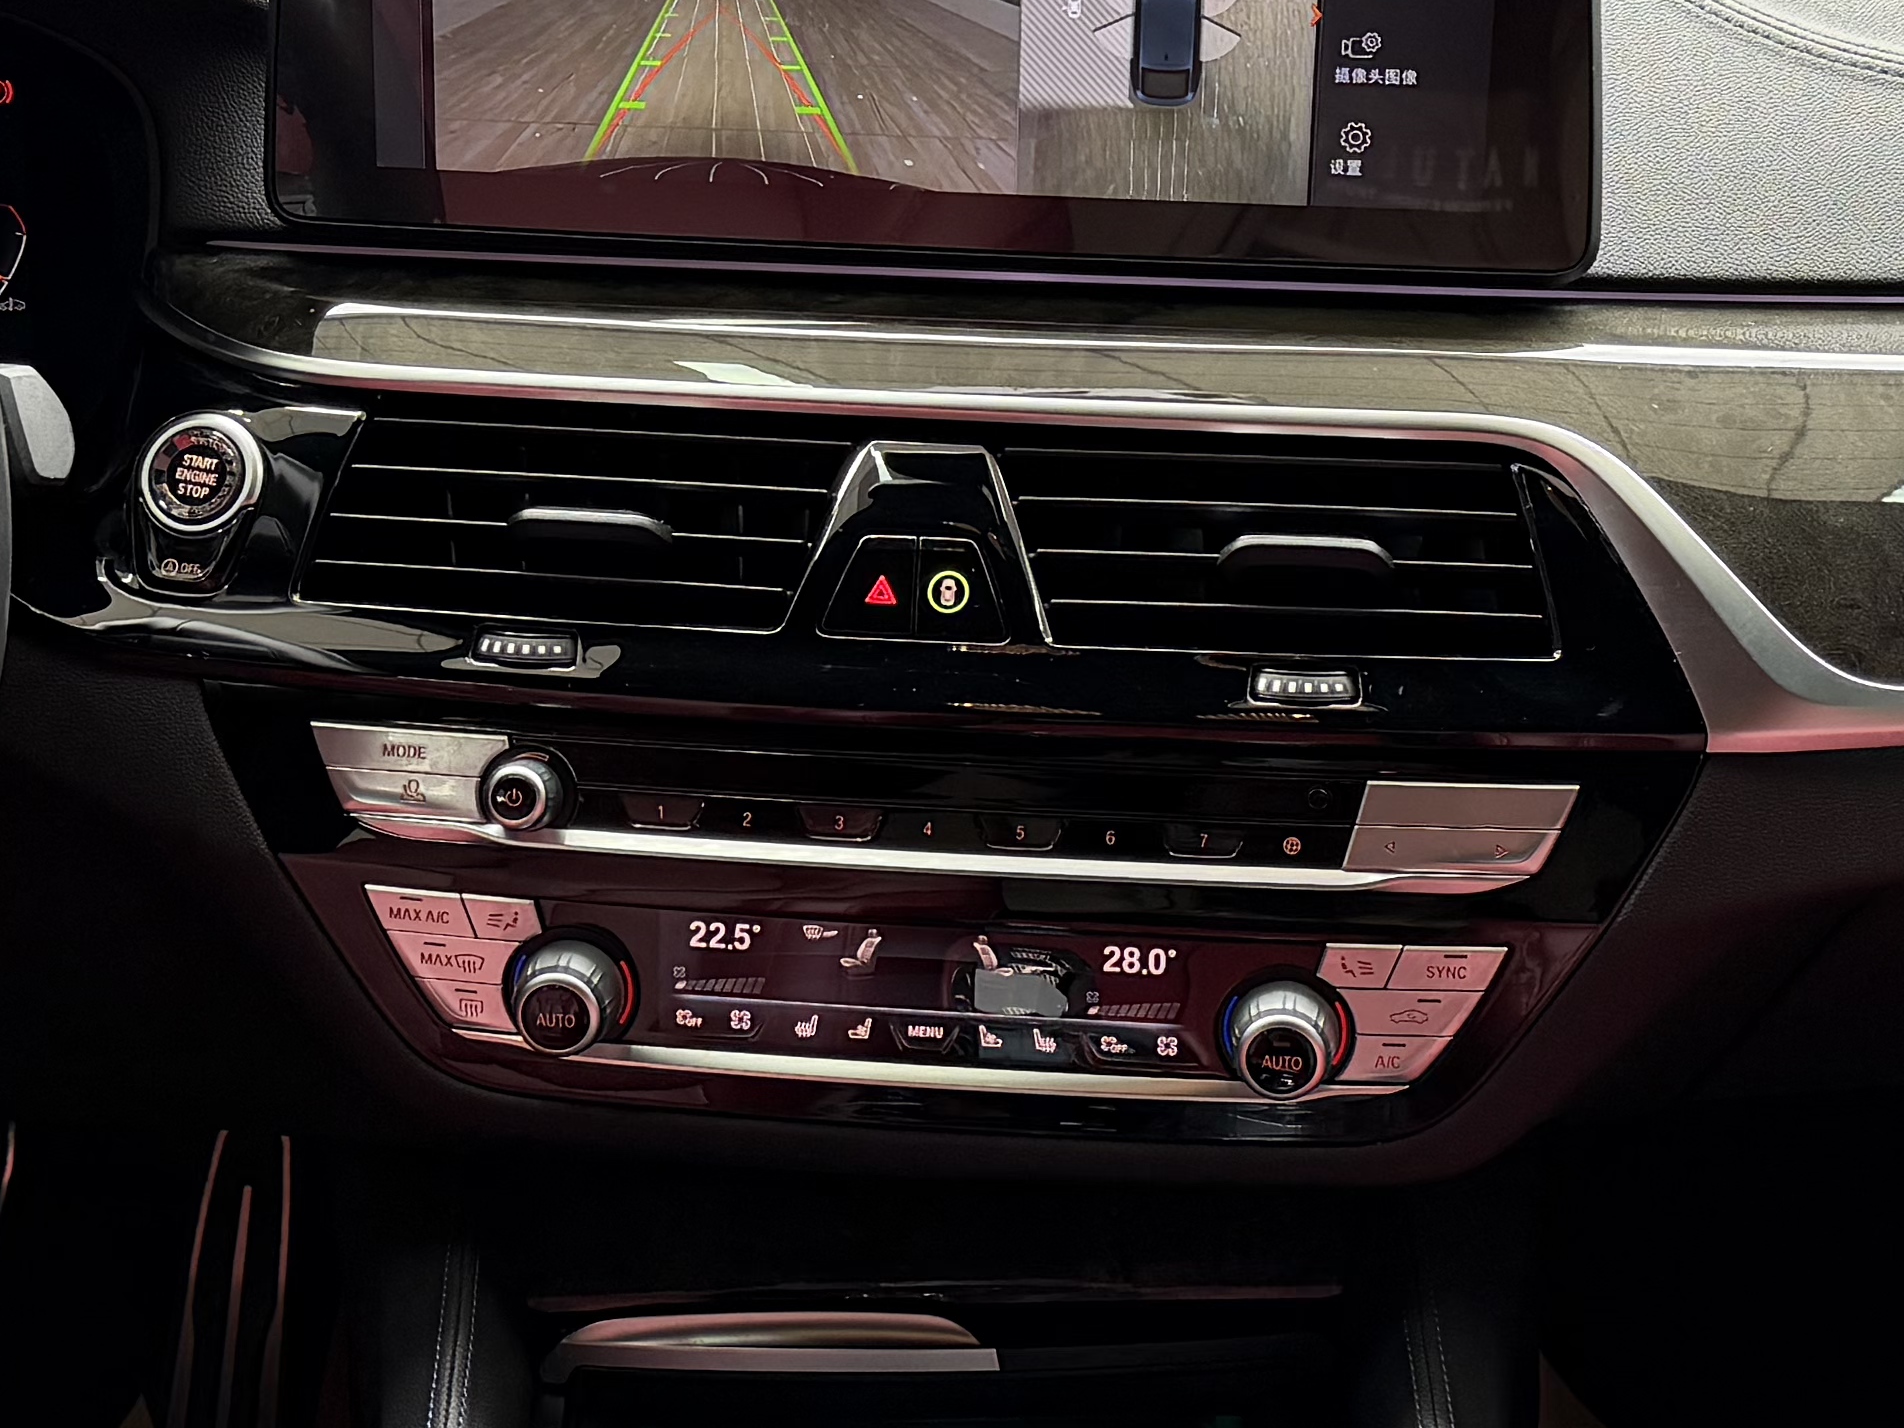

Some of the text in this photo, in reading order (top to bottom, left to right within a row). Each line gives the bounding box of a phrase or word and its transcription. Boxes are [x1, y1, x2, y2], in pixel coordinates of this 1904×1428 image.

[1335, 67, 1418, 86] 摄像头图像
[1329, 158, 1363, 177] 设置
[182, 453, 219, 471] START
[175, 467, 218, 486] ENGINE
[177, 483, 209, 499] STOP
[382, 743, 428, 760] MODE
[657, 805, 664, 820] 1
[742, 811, 752, 827] 2
[834, 815, 844, 830] 3
[923, 821, 932, 836] 4
[1015, 825, 1025, 840] 5
[1105, 830, 1116, 845] 6
[1199, 833, 1208, 848] 7
[388, 906, 450, 924] MAX A/C
[689, 920, 761, 950] 22.5°
[420, 951, 453, 967] MAX
[1103, 945, 1177, 975] 28.0°
[1426, 965, 1467, 980] SYNC
[536, 1012, 576, 1028] AUTO
[907, 1025, 944, 1039] MENU
[1262, 1055, 1303, 1071] AUTO
[1374, 1055, 1401, 1070] A/C
